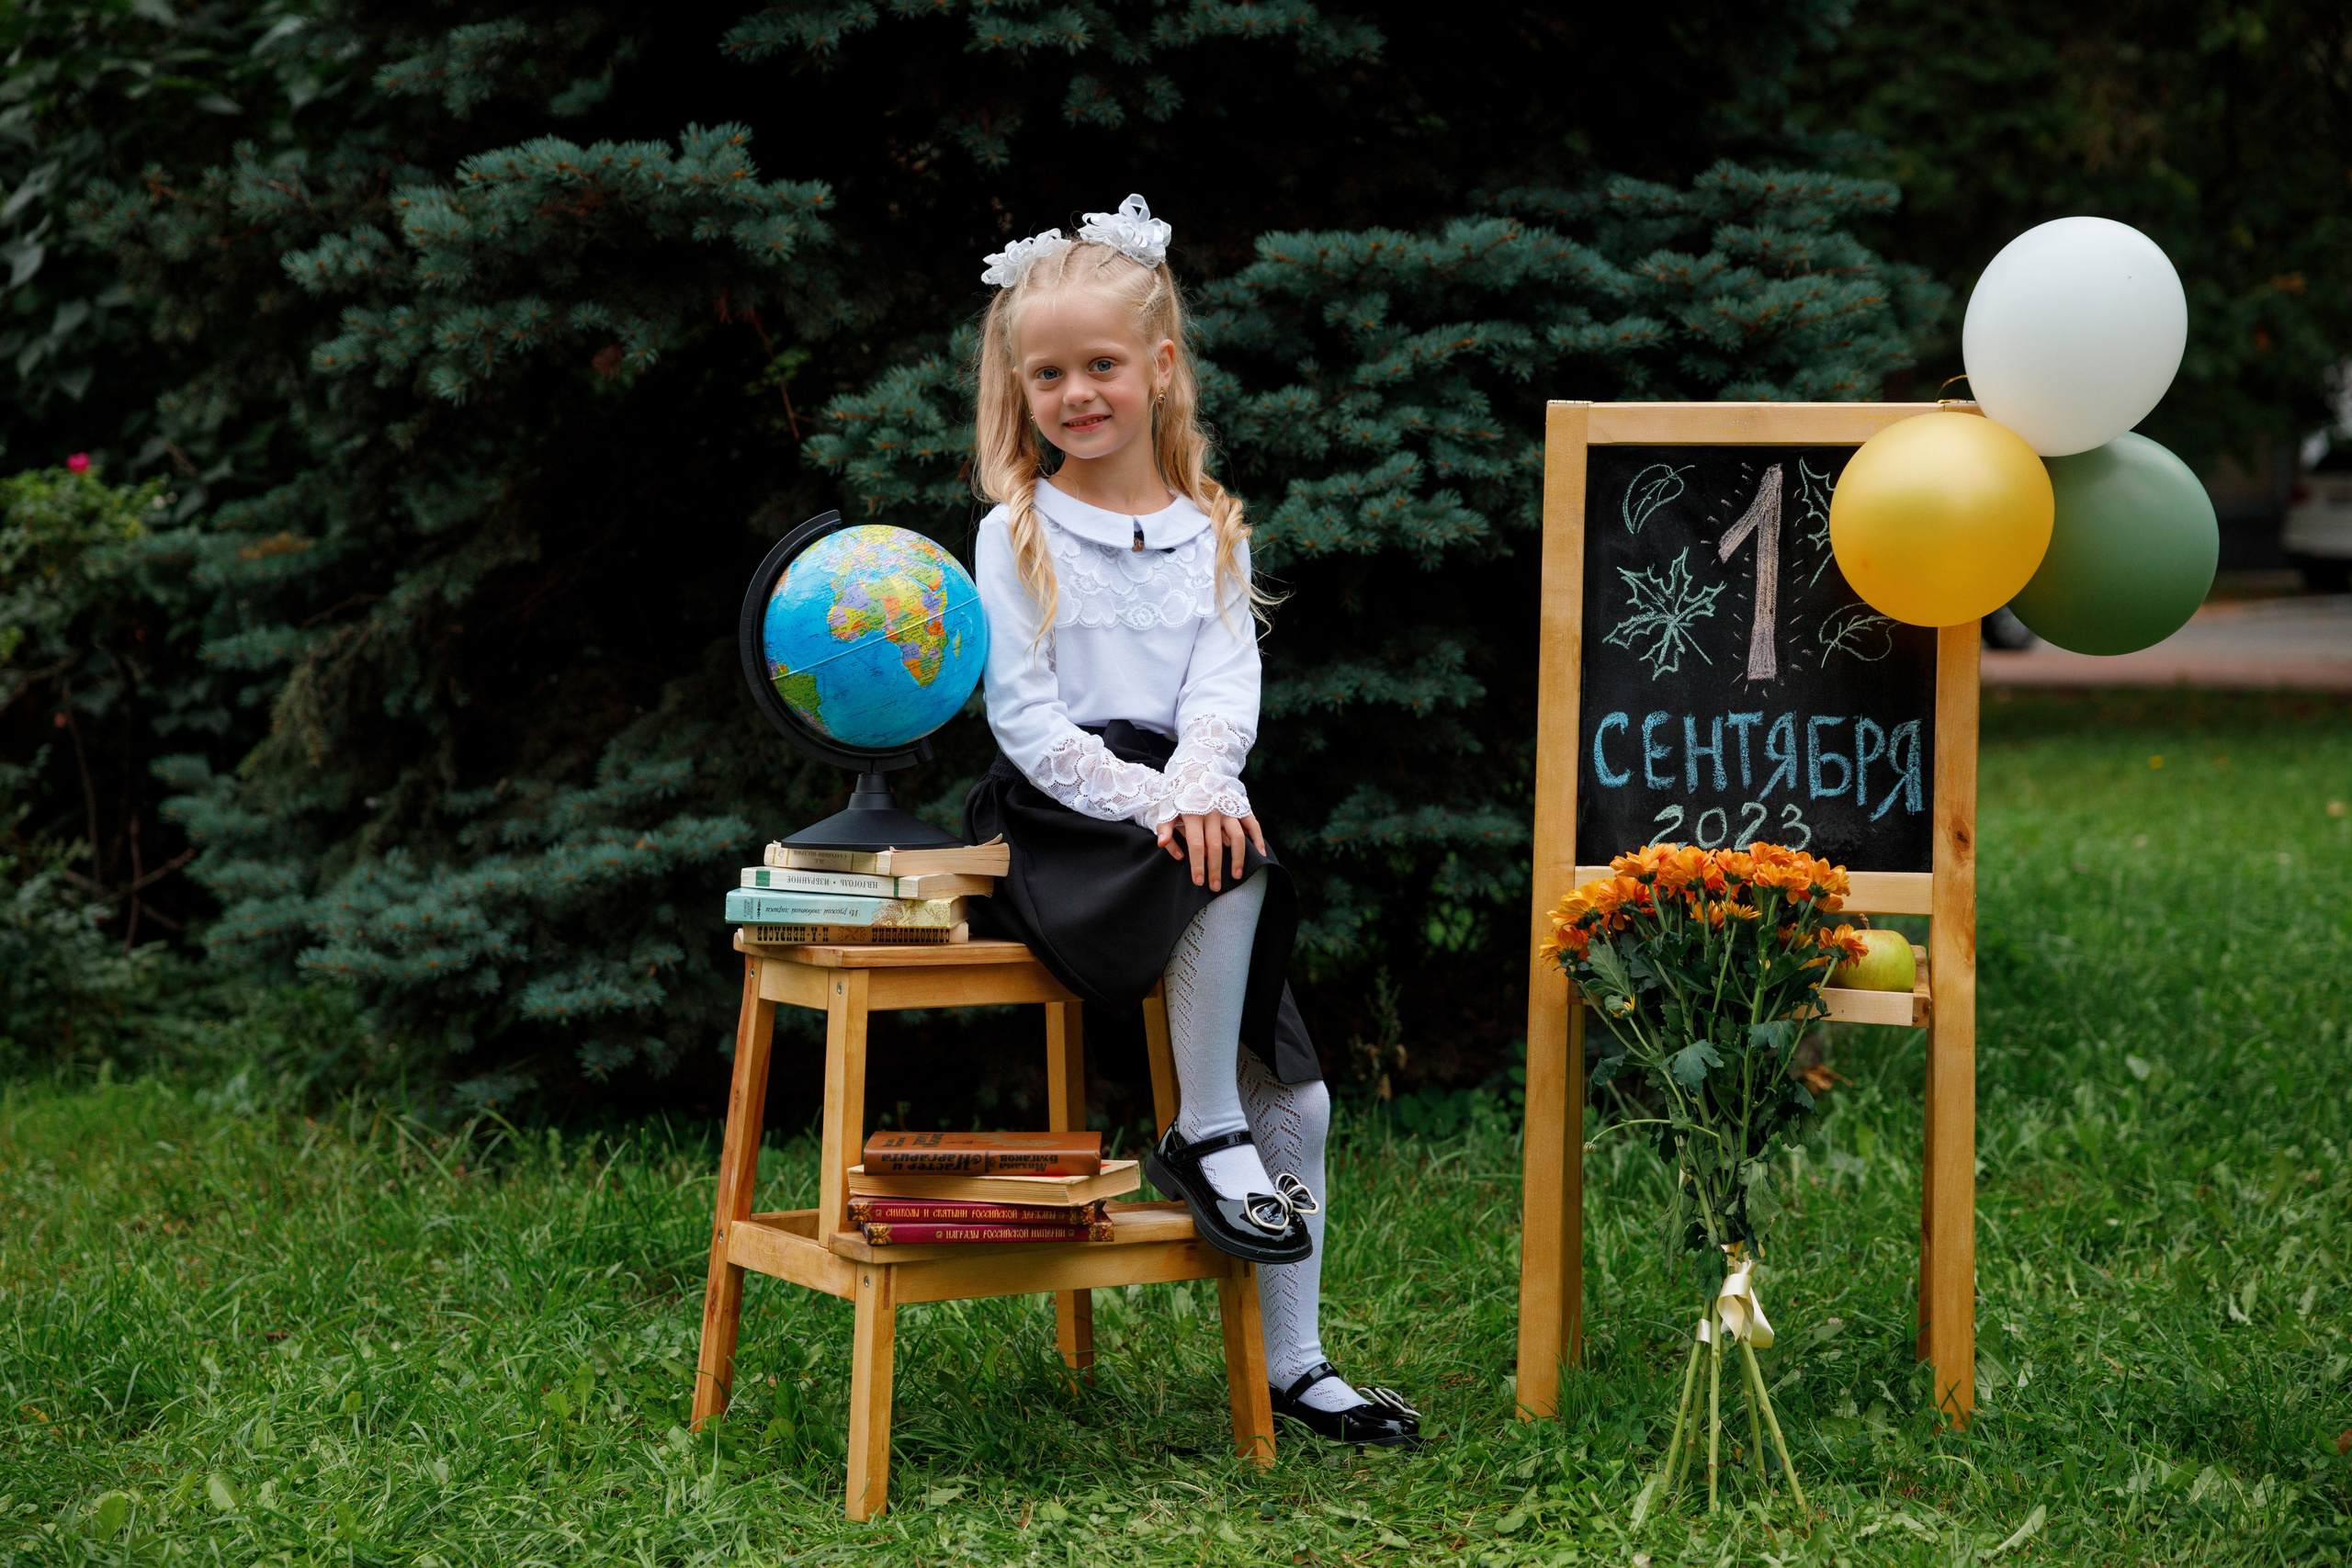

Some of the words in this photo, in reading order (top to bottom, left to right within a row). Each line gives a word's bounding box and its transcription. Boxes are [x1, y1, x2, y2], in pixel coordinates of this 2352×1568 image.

[1718, 462, 1783, 682] 1
[1593, 710, 1925, 821] СЕНТЯБРЯ
[1649, 802, 1813, 851] 2023
[786, 875, 830, 886] ИЗБРАННОЕ
[765, 906, 790, 914] лирики
[791, 908, 822, 916] любовной
[824, 907, 848, 916] русской
[849, 908, 859, 917] Из
[871, 928, 950, 943] СТИХОТВОРЕНИЯ
[881, 1154, 981, 1165] Маргарита
[1000, 1155, 1058, 1164] Булгаков
[892, 1163, 903, 1171] и
[999, 1163, 1047, 1172] Михаил
[885, 1208, 920, 1218] СИМВОЛЫ
[923, 1209, 930, 1217] И
[933, 1209, 967, 1218] СВЯТЫНИ
[971, 1209, 1018, 1219] РОССИЙСКОЙ
[1021, 1210, 1057, 1220] ДЕРЖАВЫ
[945, 1230, 979, 1239] НАГРАДЫ
[982, 1228, 1029, 1239] РОССИЙСКОЙ
[1031, 1229, 1066, 1238] ИМПЕРИИ
